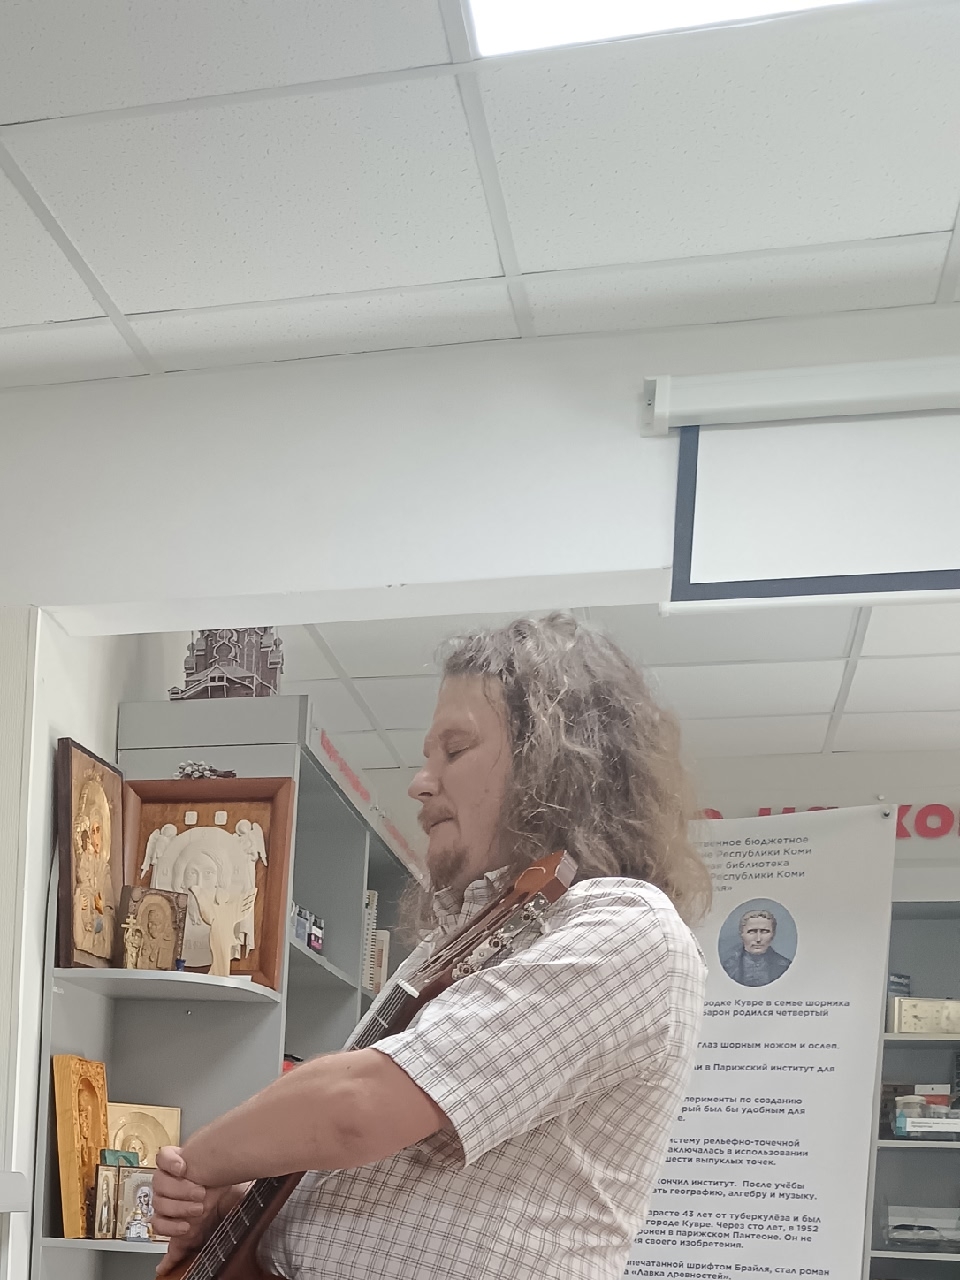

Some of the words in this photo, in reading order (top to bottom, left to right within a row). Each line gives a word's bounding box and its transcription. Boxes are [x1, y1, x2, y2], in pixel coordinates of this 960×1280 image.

[783, 847, 811, 856] Коми
[726, 860, 789, 869] библиотека
[777, 870, 805, 878] Коми
[733, 1009, 773, 1017] родился
[713, 1064, 768, 1072] Парижский
[742, 1106, 785, 1114] удобным
[668, 1146, 724, 1155] аключалась
[779, 1192, 817, 1201] музыку.
[802, 1215, 821, 1223] был
[676, 1230, 729, 1239] парижском
[645, 1238, 677, 1246] своего
[632, 1269, 665, 1277] «Лавка
[687, 1263, 731, 1271] шрифтом
[735, 1264, 772, 1274] Брайля,
[799, 1268, 829, 1276] роман
